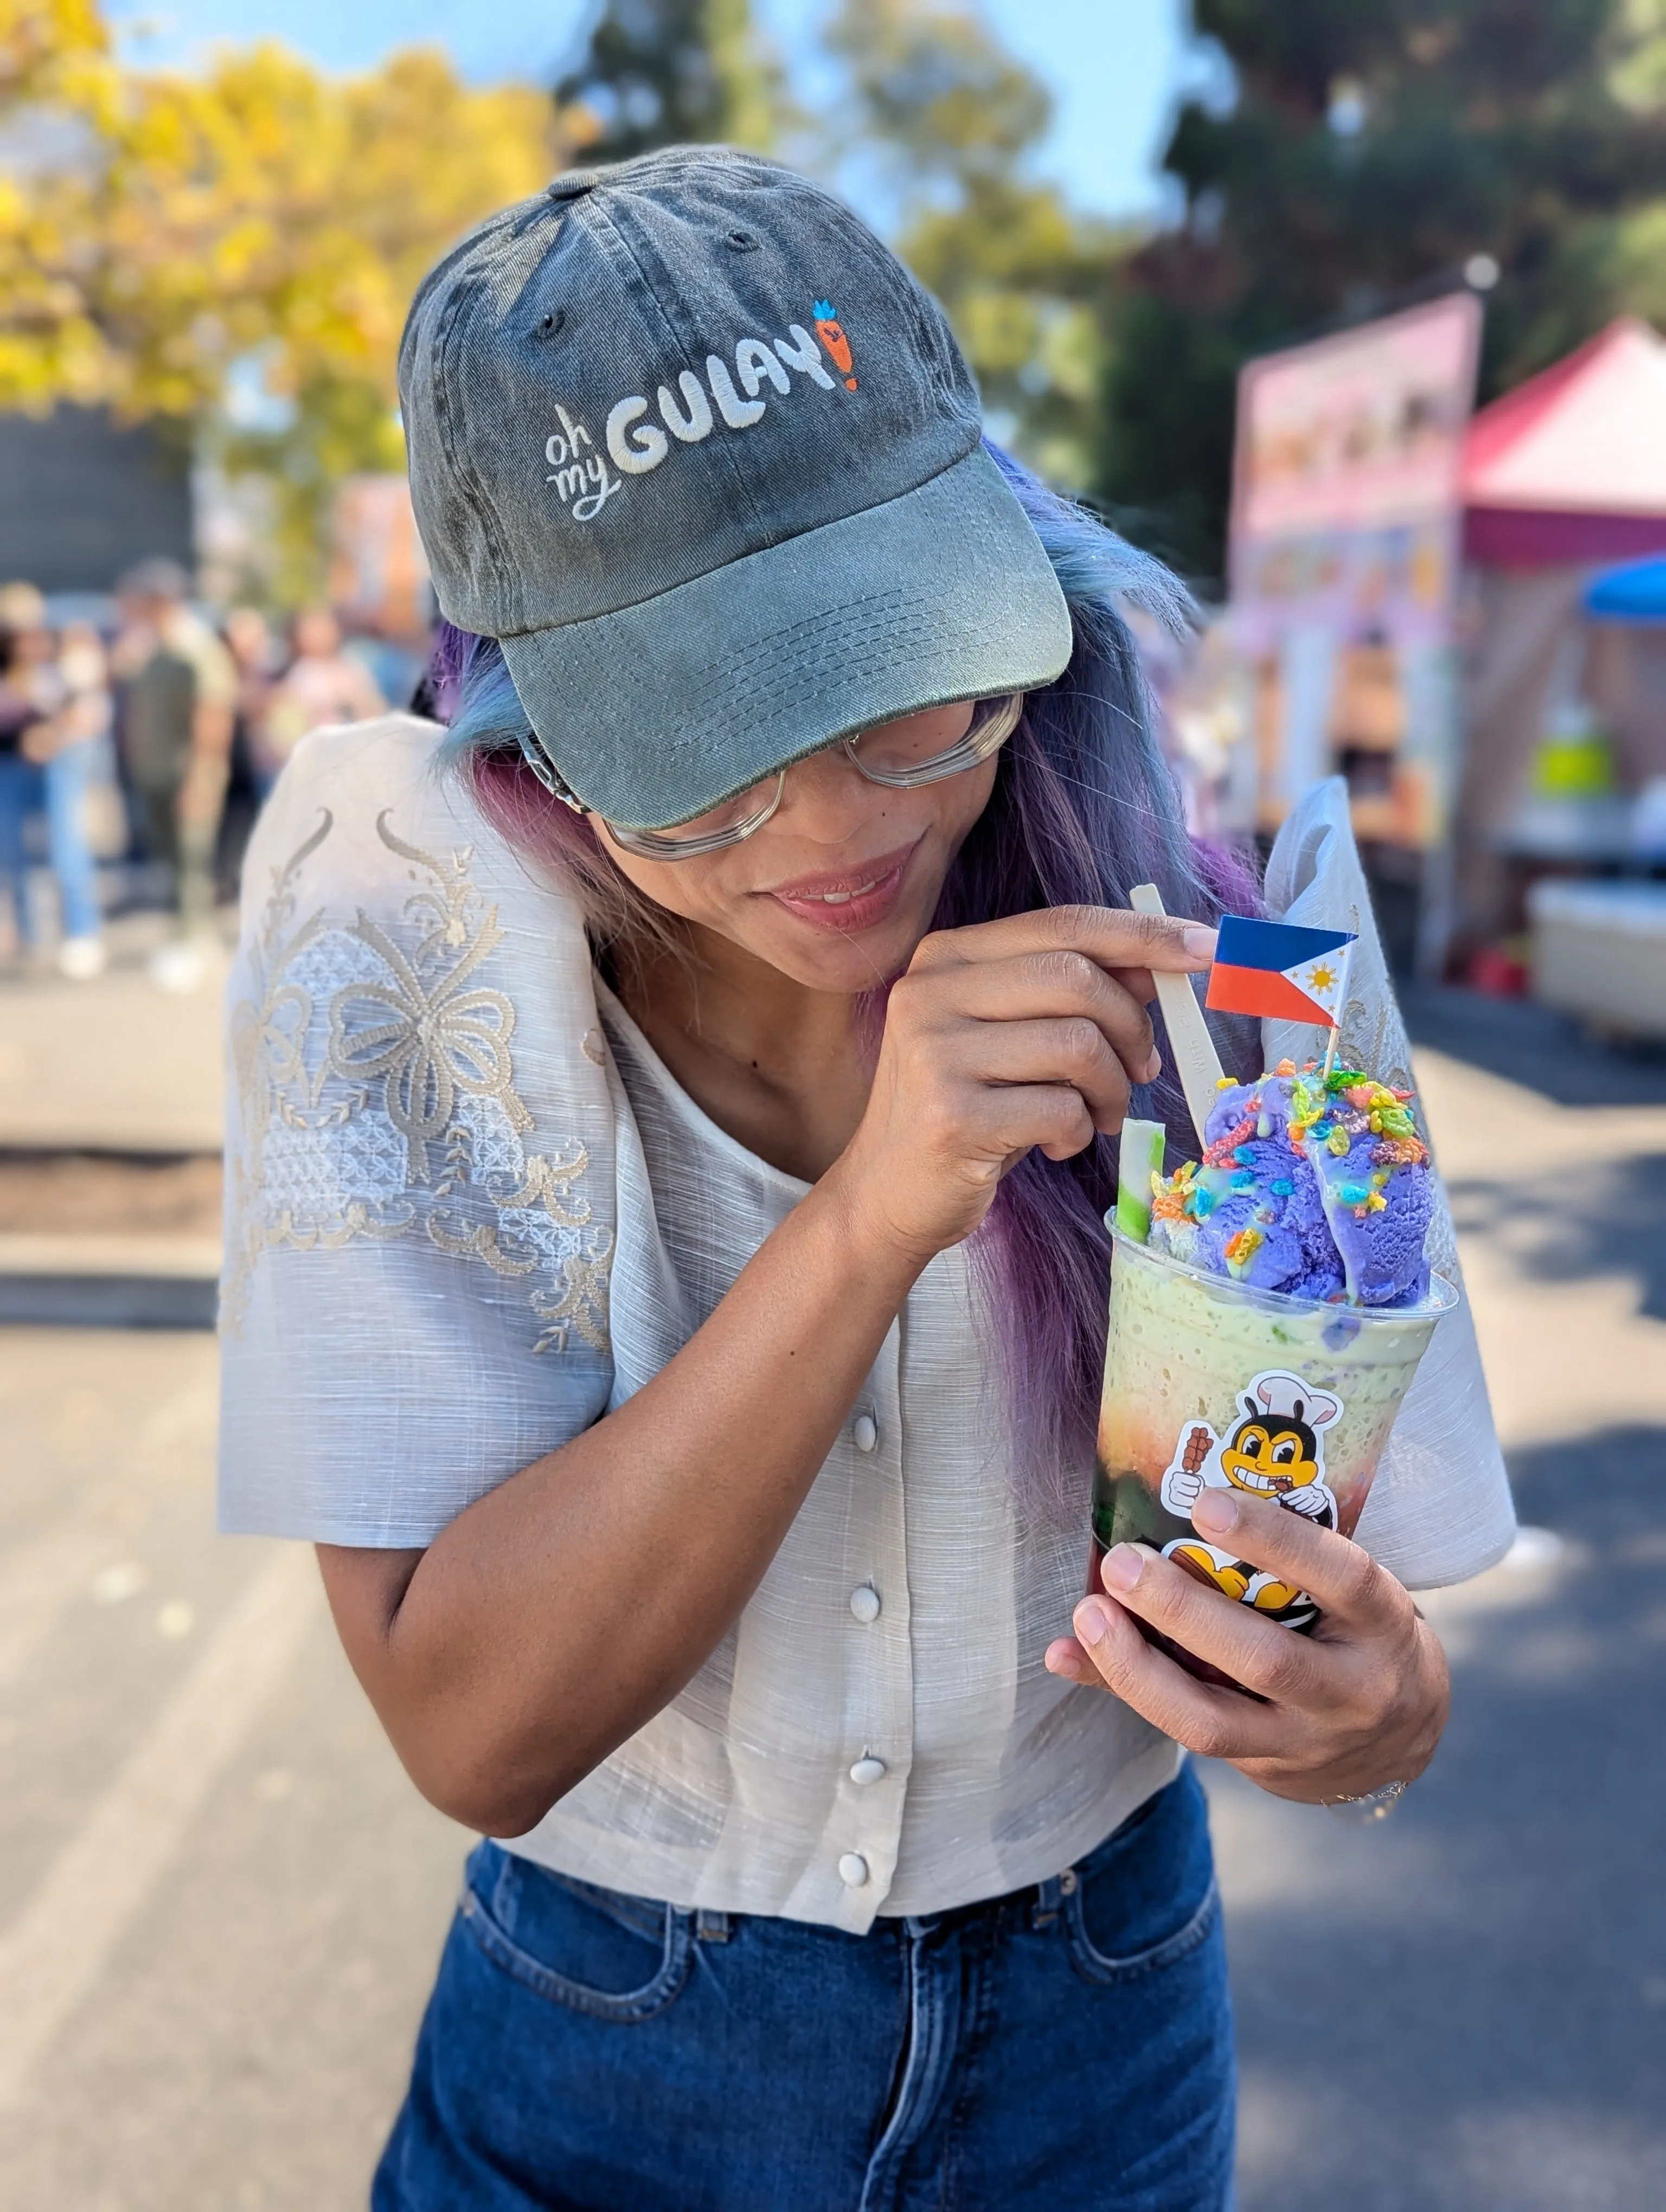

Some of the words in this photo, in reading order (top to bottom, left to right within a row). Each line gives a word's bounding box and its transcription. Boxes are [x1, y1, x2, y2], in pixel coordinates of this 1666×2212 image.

[545, 403, 592, 466] oh
[546, 454, 622, 522] my
[1188, 1038, 1207, 1075] With
